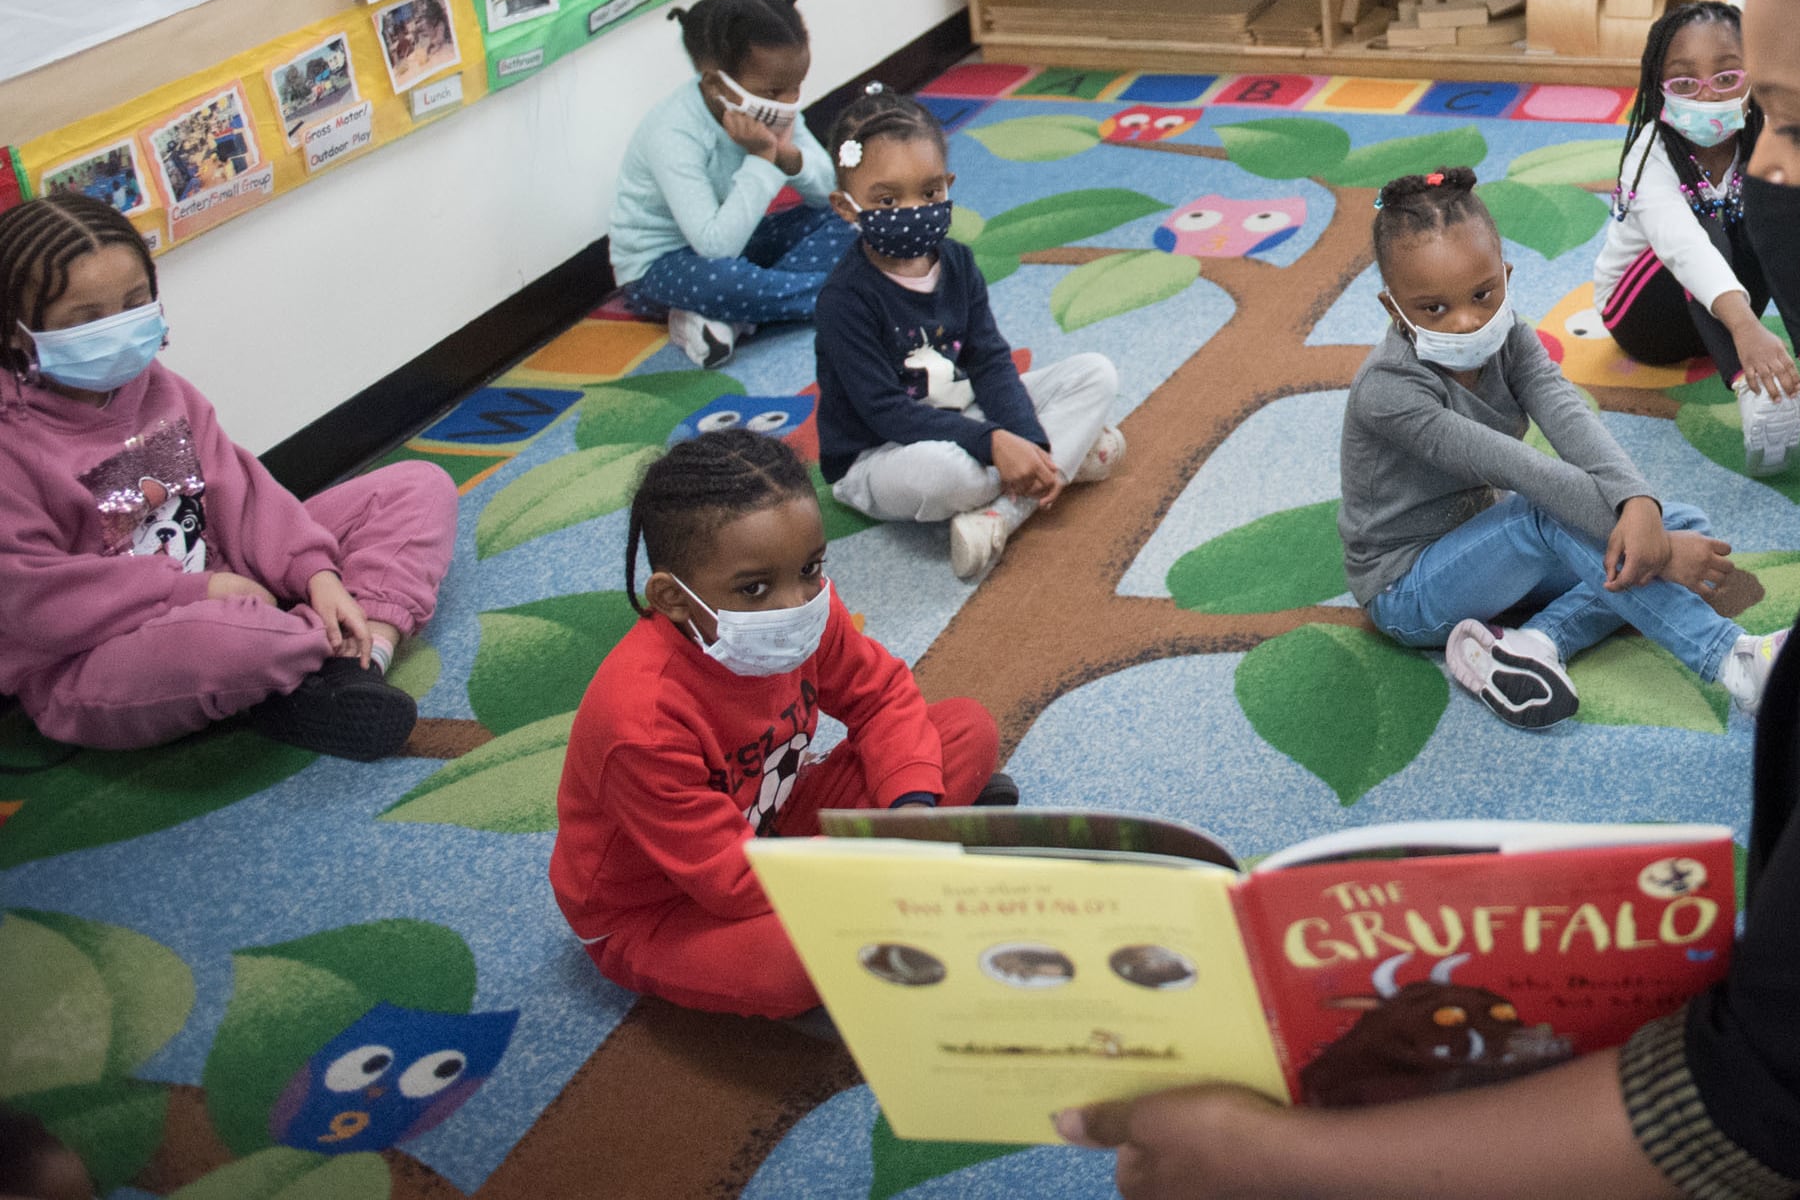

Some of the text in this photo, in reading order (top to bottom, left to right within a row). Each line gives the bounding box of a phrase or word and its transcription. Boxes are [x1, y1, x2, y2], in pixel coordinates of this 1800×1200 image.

[423, 86, 453, 106] Lunch
[1036, 75, 1084, 95] A
[1236, 80, 1281, 103] B
[1445, 90, 1492, 111] C
[304, 103, 369, 145] Gross Motor/
[310, 129, 373, 167] Outdoor Play
[242, 173, 272, 194] Group
[1323, 881, 1402, 911] THE
[1284, 896, 1719, 969] GRUFFALO
